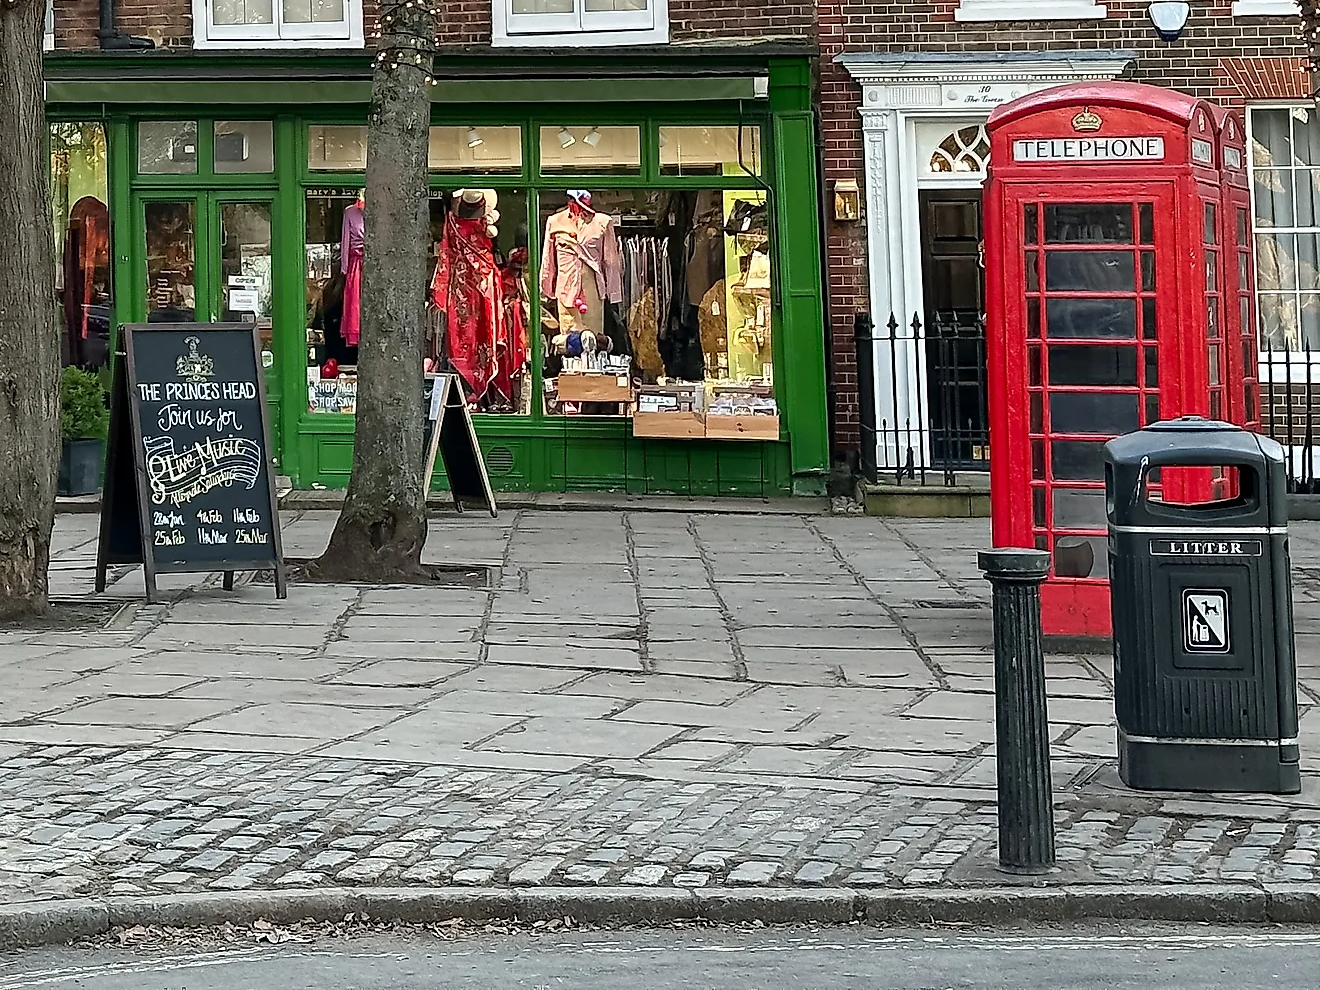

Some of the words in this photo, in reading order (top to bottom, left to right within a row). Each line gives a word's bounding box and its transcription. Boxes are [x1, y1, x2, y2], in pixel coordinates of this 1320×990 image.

[1018, 138, 1159, 158] TELEPHONE
[136, 383, 161, 401] THE
[165, 382, 220, 401] PRINCES
[222, 382, 257, 400] HEAD
[157, 404, 195, 431] Join
[195, 409, 216, 426] us
[216, 407, 243, 432] for
[1169, 542, 1244, 554] LITTER
